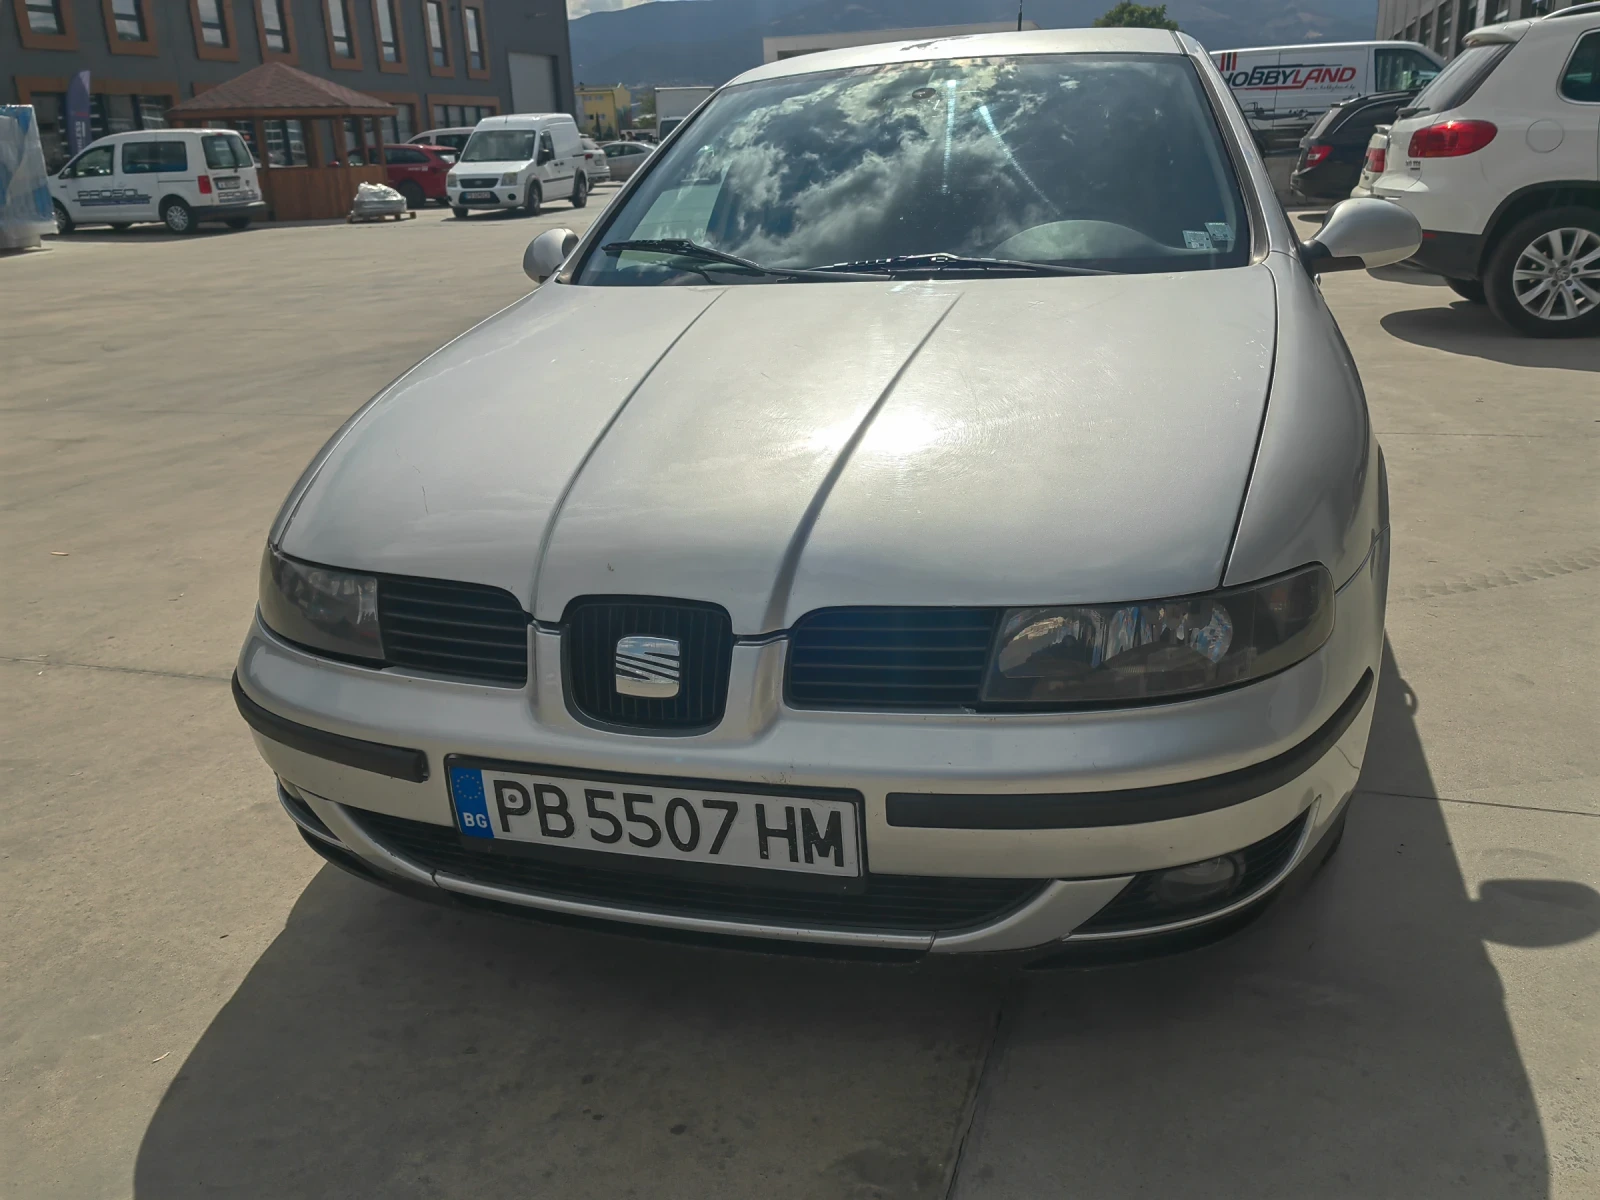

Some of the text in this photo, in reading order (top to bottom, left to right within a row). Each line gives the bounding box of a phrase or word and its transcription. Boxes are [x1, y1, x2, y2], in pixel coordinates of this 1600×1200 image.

[463, 812, 488, 829] BG
[493, 779, 844, 868] PB 5507 HM
